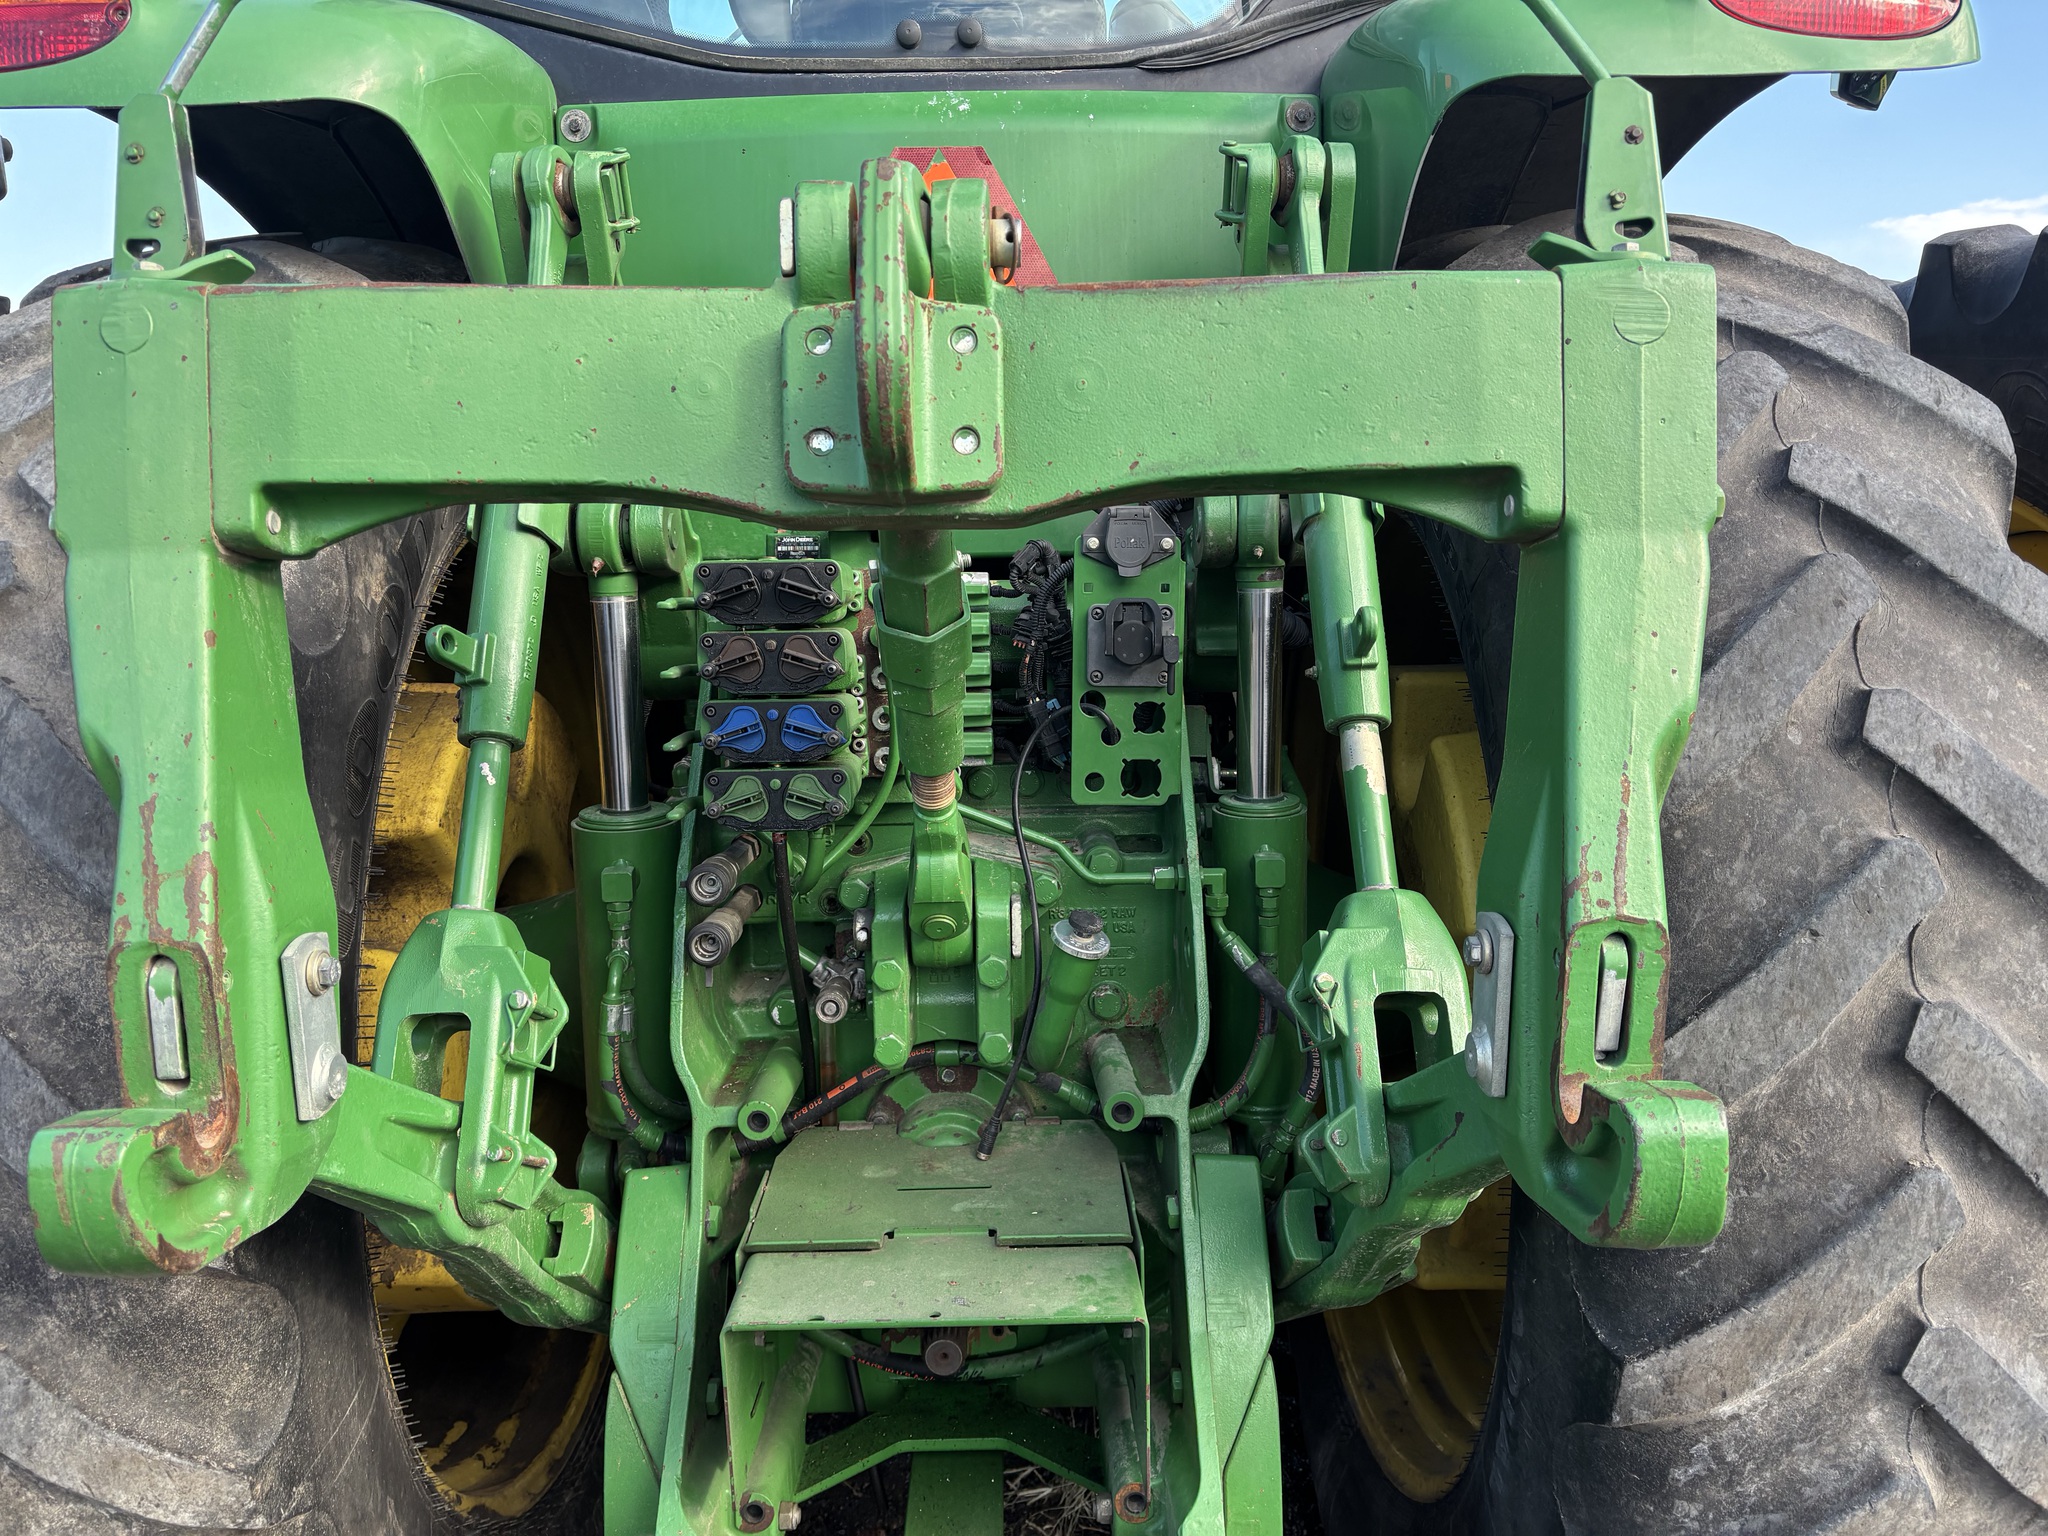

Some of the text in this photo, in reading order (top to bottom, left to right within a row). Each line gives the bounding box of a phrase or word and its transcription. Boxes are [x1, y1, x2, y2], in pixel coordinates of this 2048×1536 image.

[1114, 537, 1146, 549] Pollak
[1111, 905, 1137, 918] RAW
[1112, 920, 1136, 934] USA
[1118, 964, 1127, 977] 2
[1312, 1059, 1320, 1067] IN
[1309, 1066, 1321, 1090] MADE
[809, 1097, 823, 1110] 210
